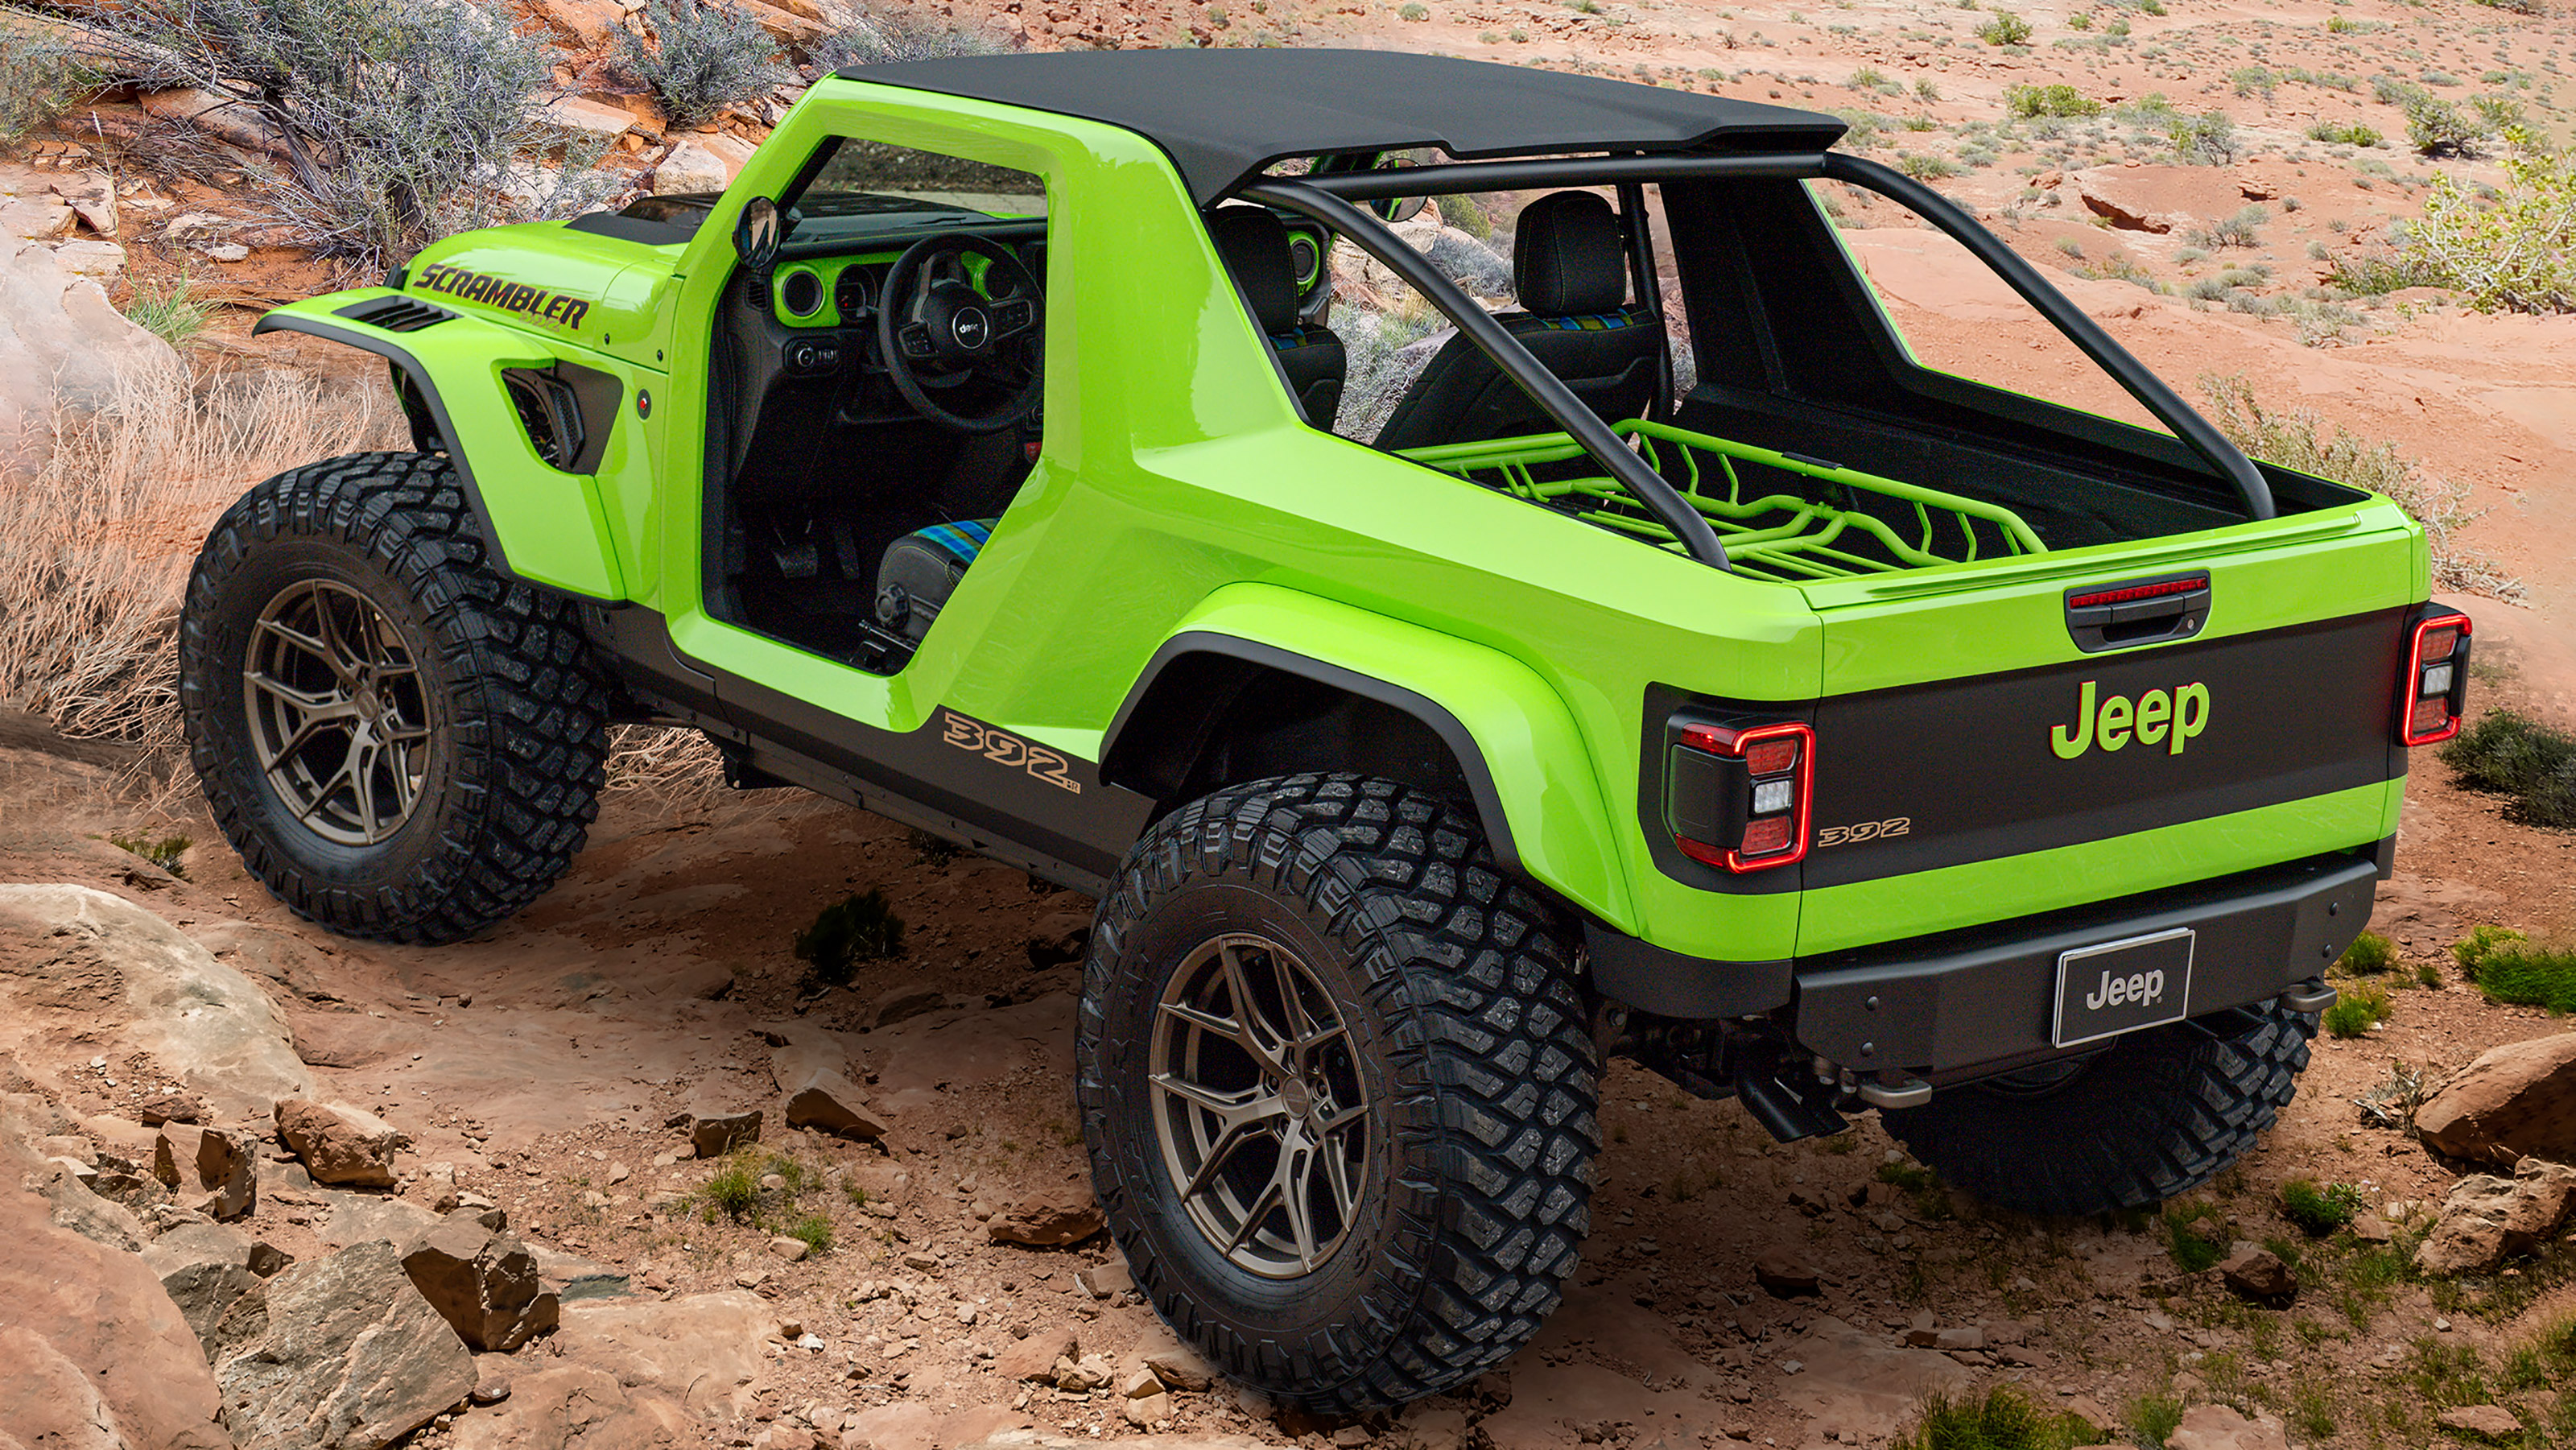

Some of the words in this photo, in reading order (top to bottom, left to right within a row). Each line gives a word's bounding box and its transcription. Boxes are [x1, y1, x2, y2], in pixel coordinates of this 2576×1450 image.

[413, 263, 590, 331] SCRAMBLER
[943, 711, 1081, 795] 392
[2050, 680, 2211, 760] Jeep
[1817, 816, 1911, 848] 392
[2086, 969, 2165, 1010] Jeep
